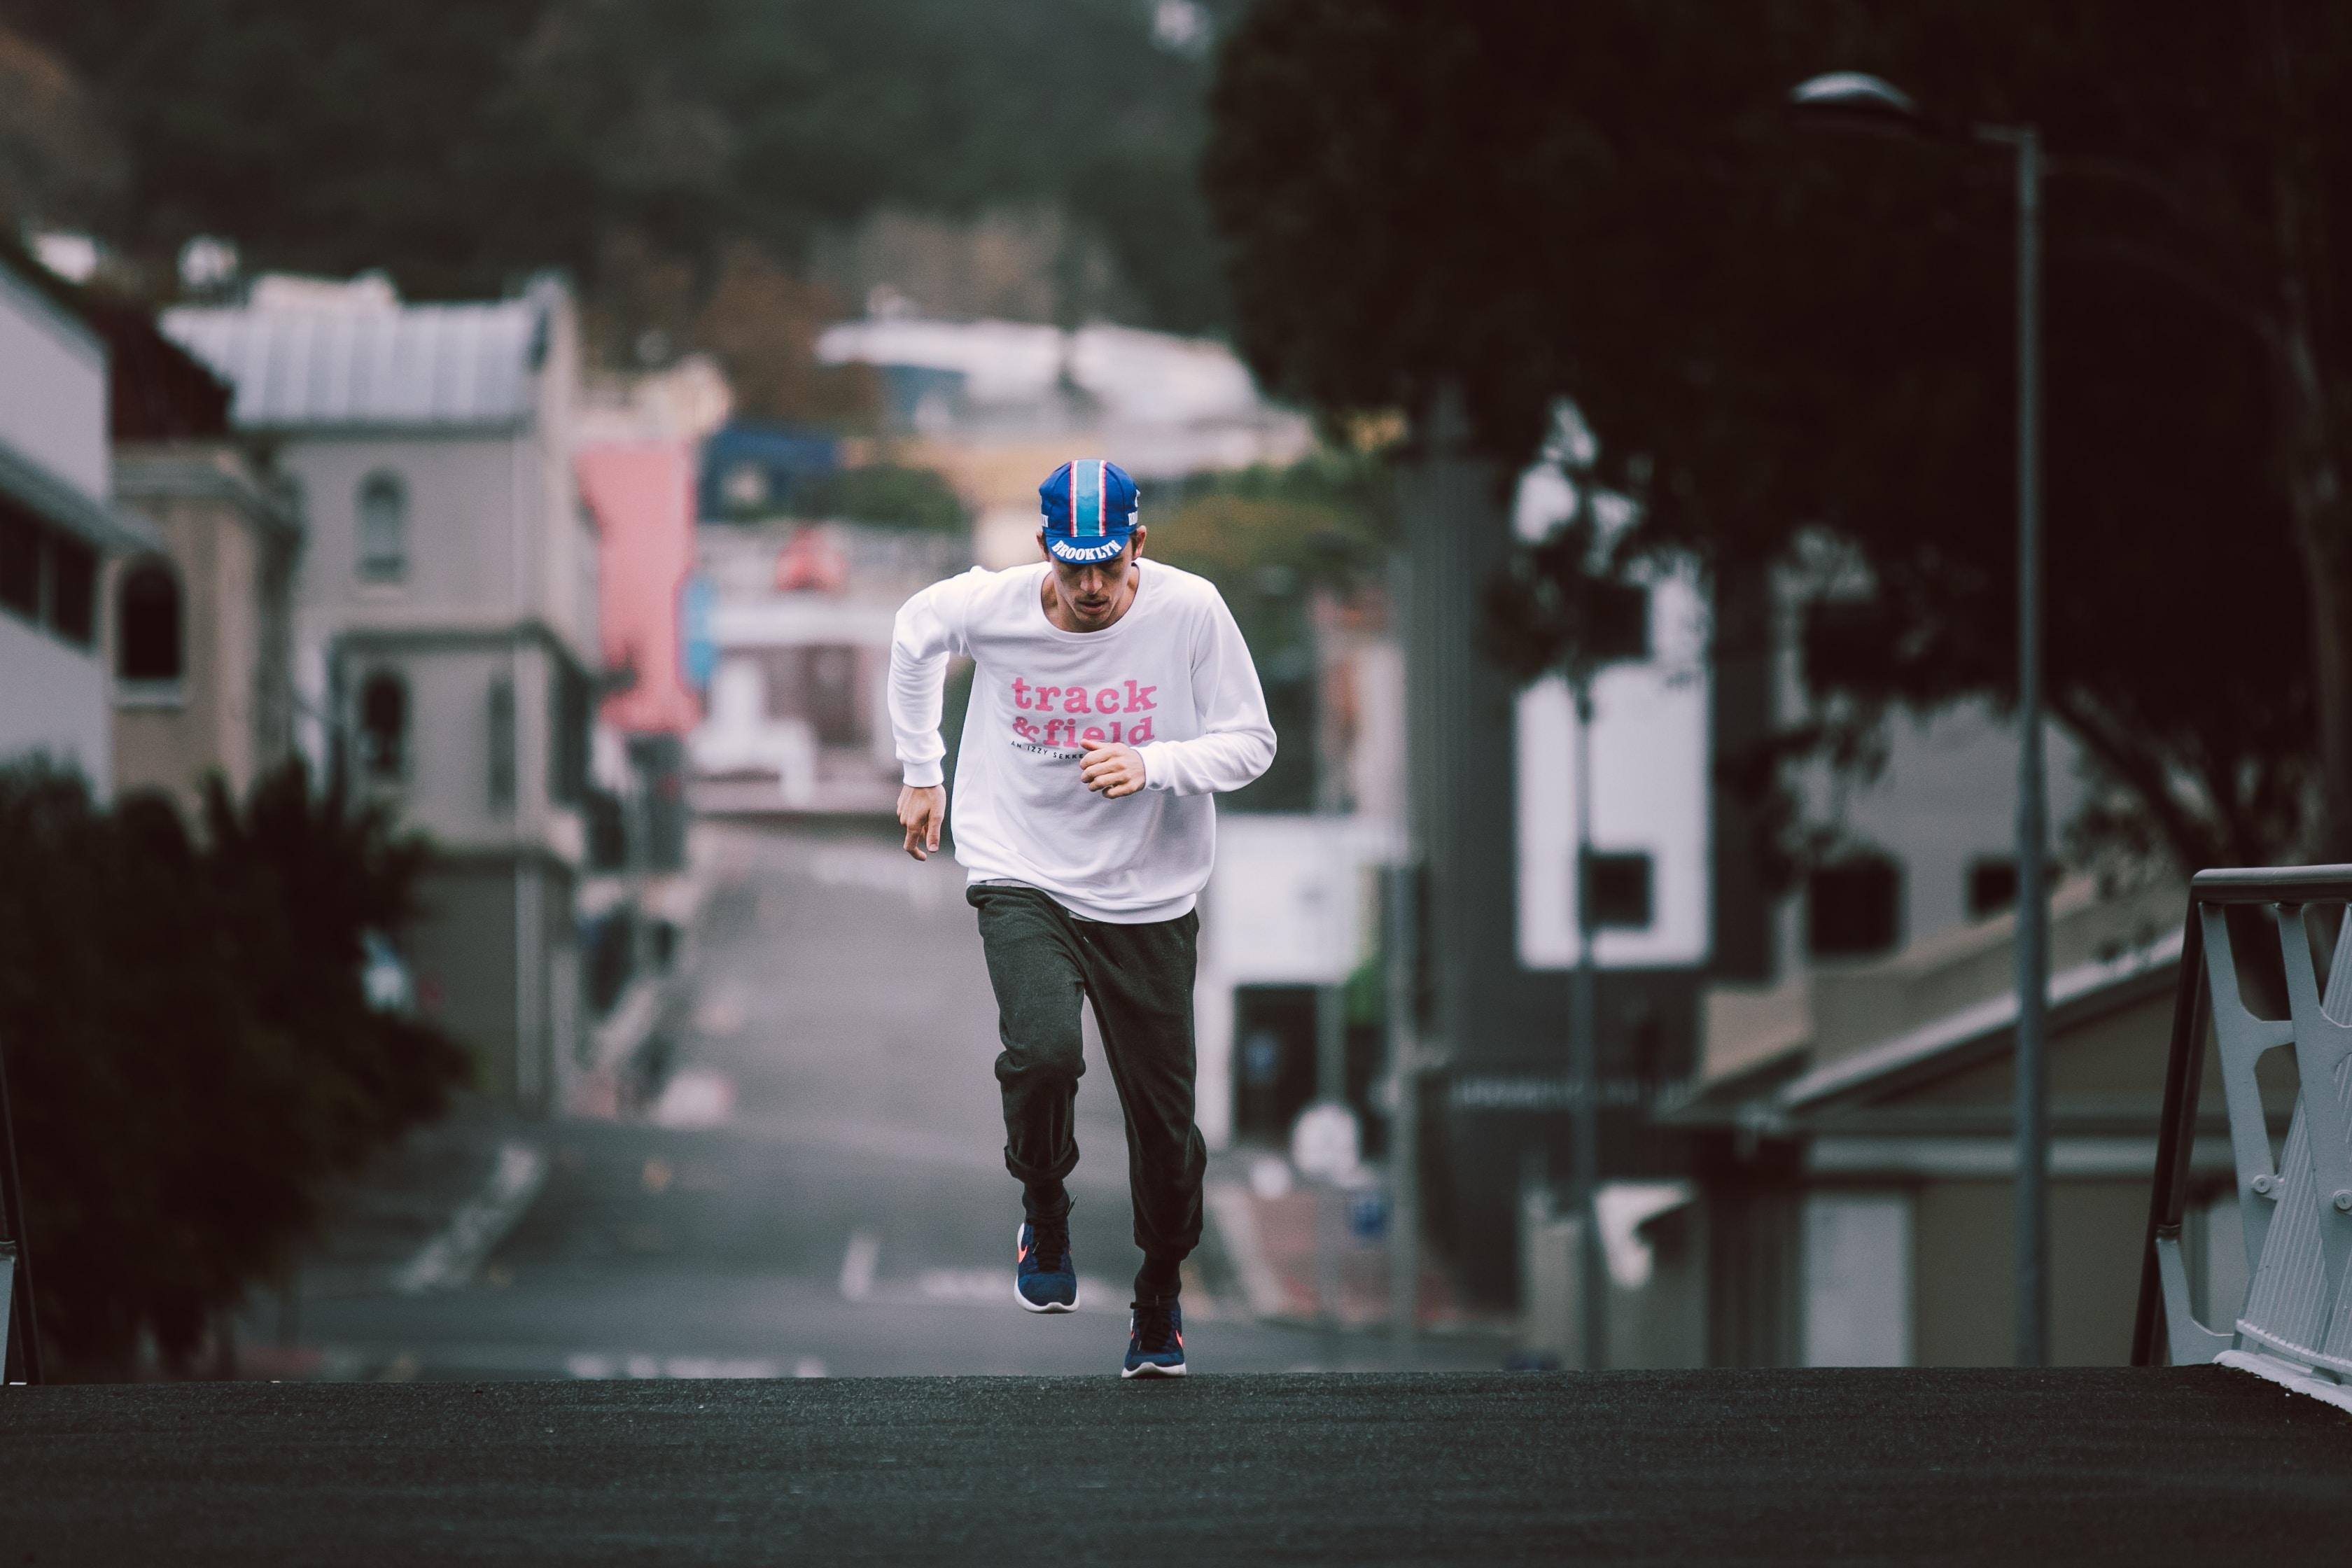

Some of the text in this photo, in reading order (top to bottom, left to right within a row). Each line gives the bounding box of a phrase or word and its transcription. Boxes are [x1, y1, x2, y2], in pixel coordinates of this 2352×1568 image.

[1051, 540, 1122, 560] BROOKLYN
[1011, 677, 1157, 714] track
[1027, 746, 1048, 755] IZZY
